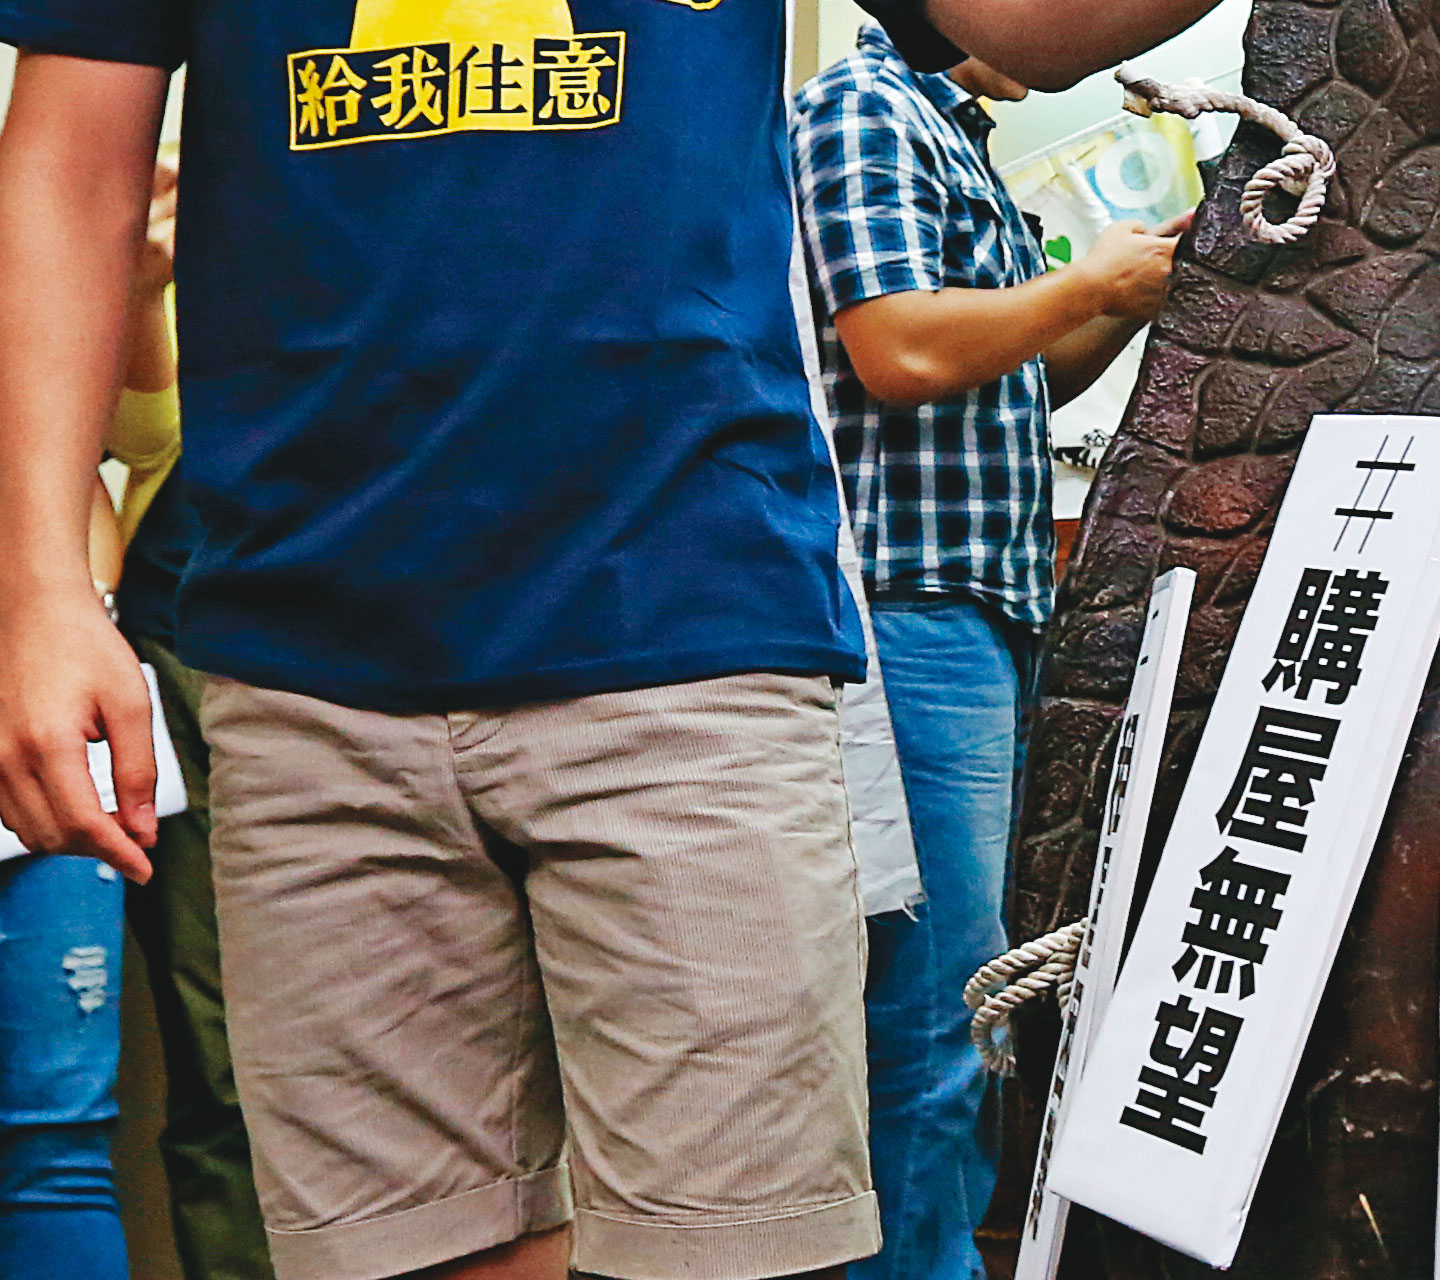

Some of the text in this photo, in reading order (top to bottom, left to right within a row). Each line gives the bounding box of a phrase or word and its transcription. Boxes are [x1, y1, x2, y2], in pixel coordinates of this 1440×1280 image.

[297, 42, 617, 137] 給我住意
[1120, 434, 1417, 1155] #購屋無望
